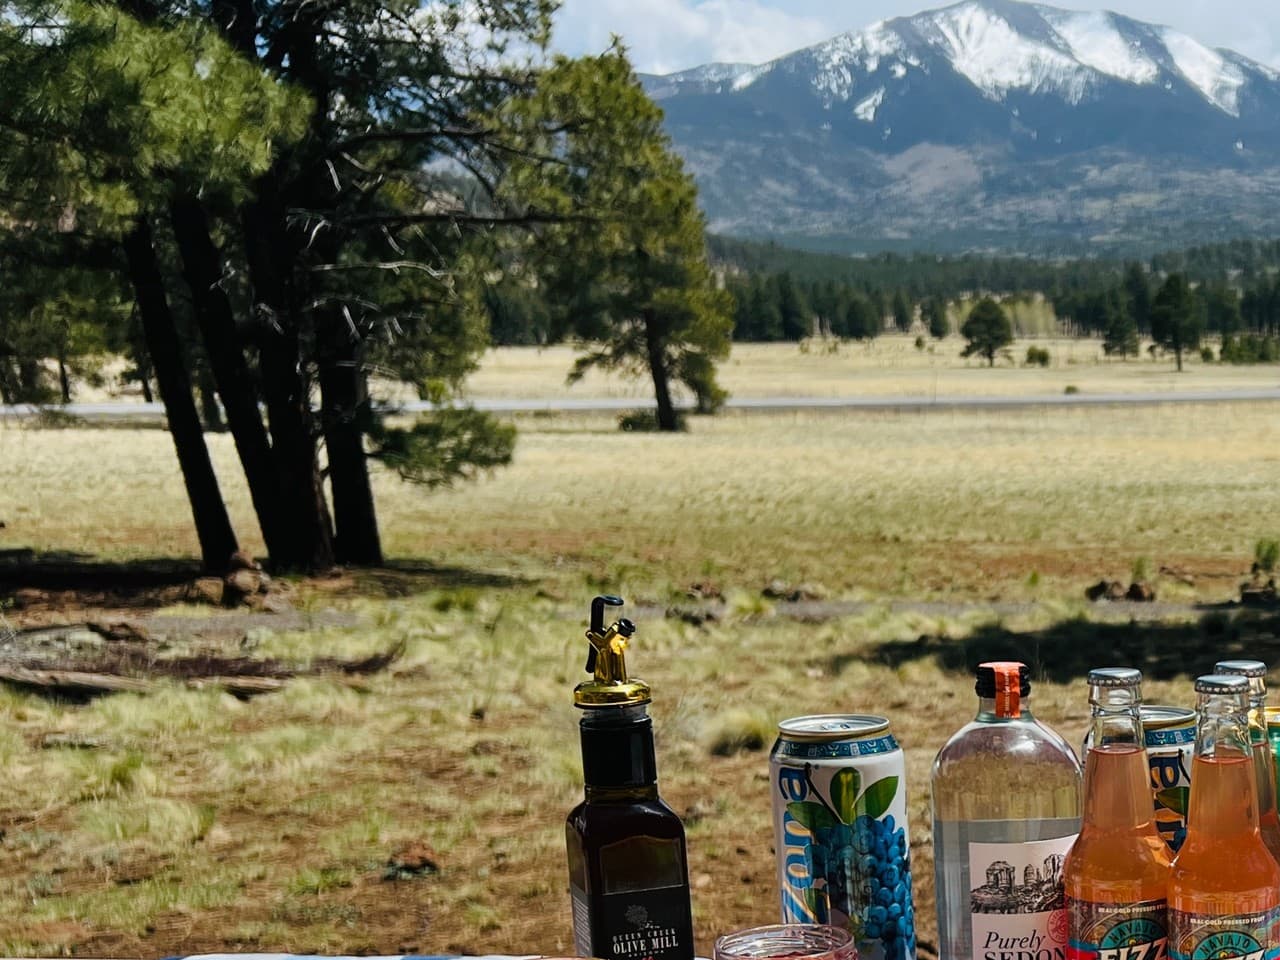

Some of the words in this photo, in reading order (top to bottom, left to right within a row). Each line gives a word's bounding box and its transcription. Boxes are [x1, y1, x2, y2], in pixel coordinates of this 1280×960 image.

[613, 939, 647, 955] OLIVE
[651, 935, 679, 950] MILL
[983, 929, 1046, 953] Purely
[1199, 935, 1250, 956] NAVAJO
